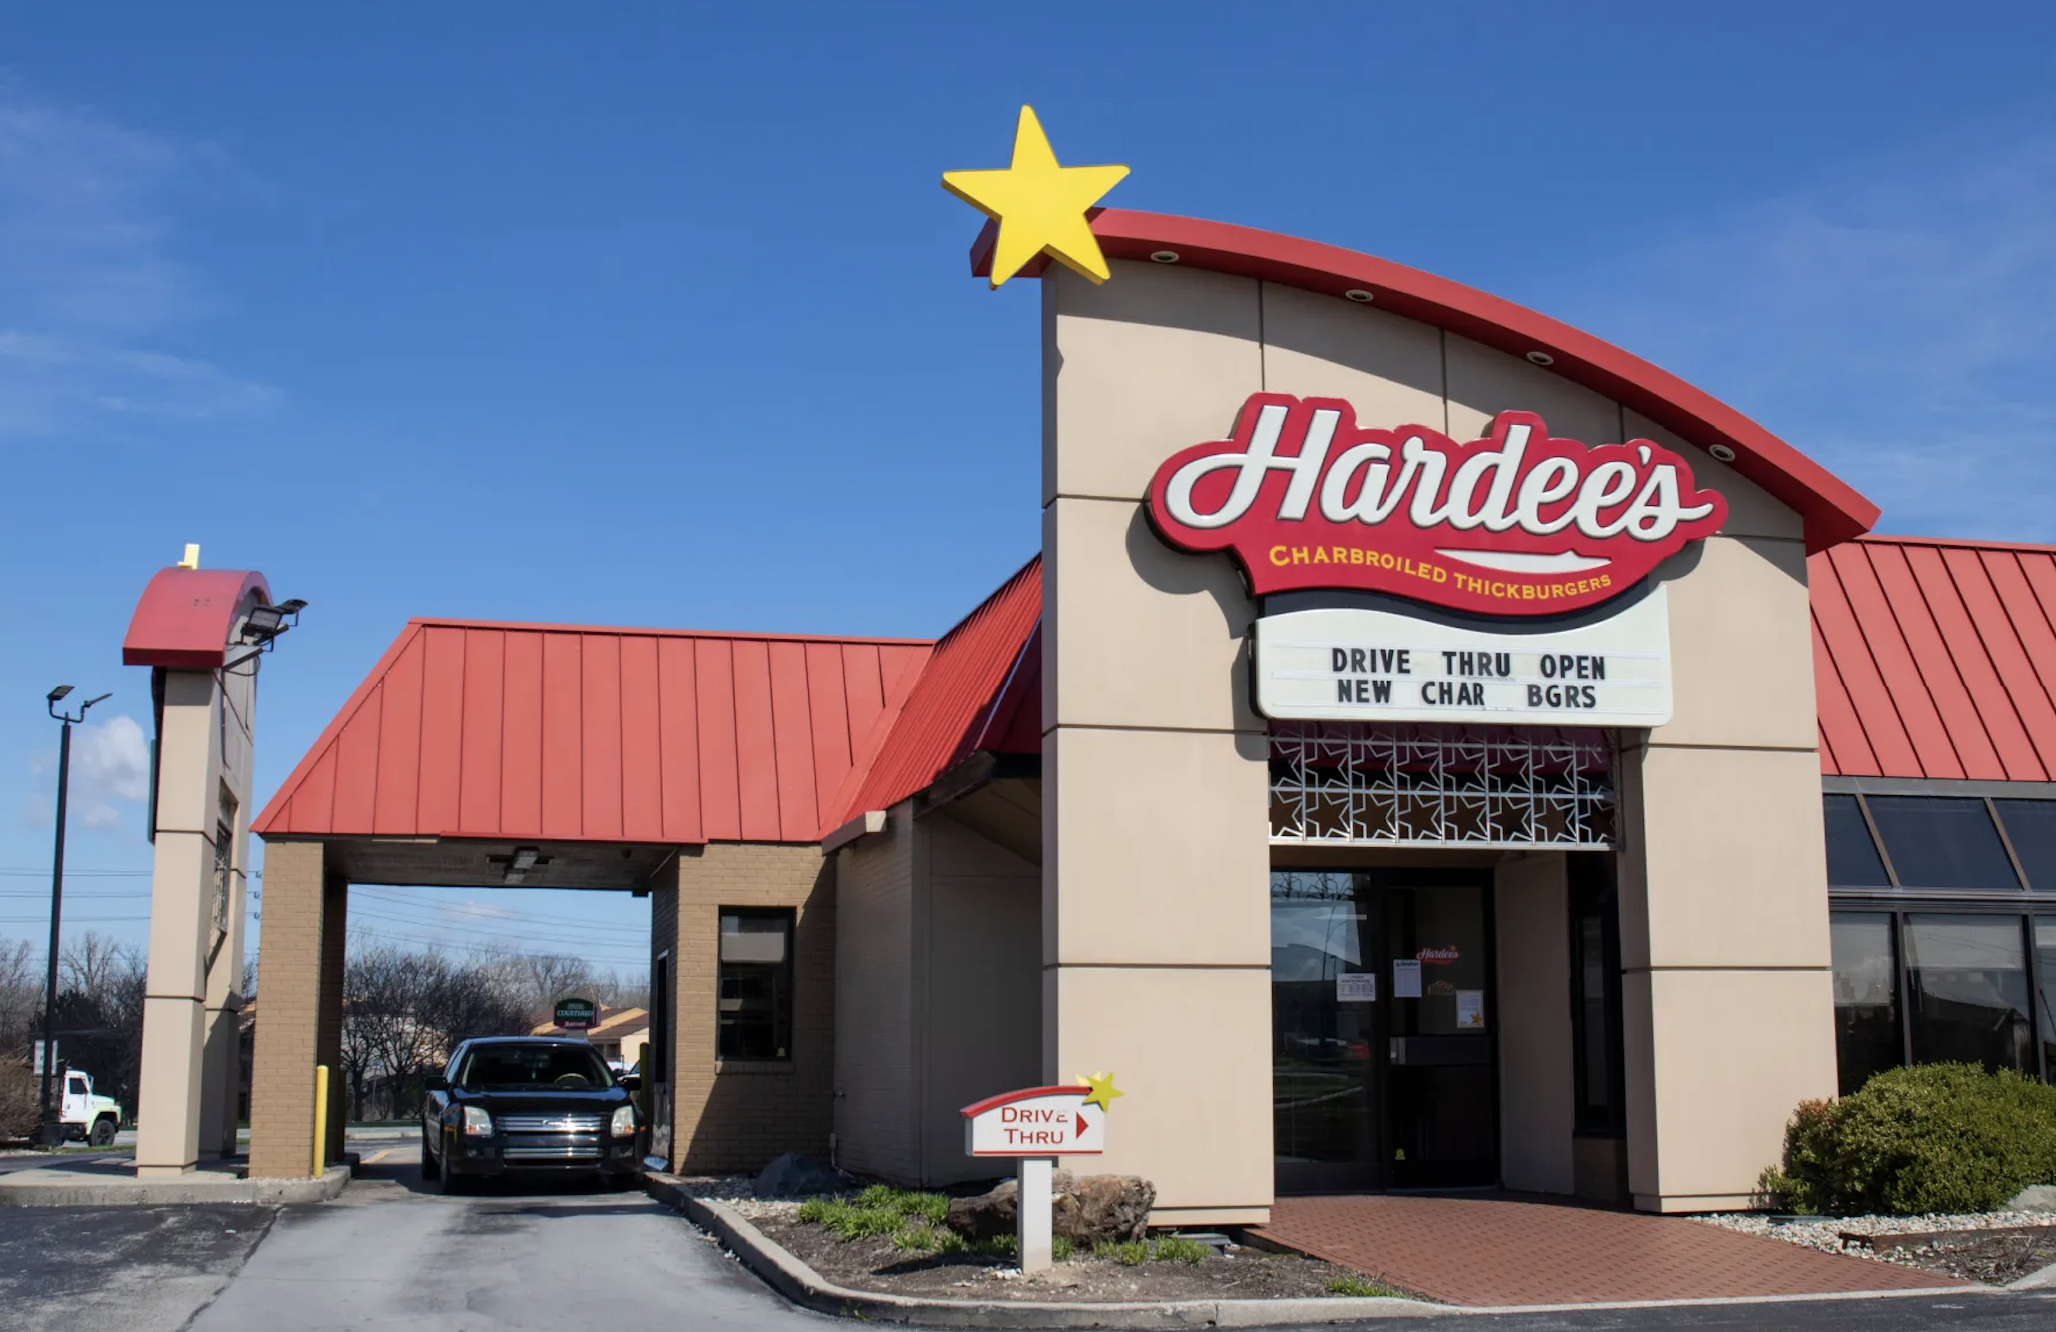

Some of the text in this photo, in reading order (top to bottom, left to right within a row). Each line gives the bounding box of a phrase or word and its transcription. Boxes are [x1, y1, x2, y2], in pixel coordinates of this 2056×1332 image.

[1164, 403, 1715, 543] Hardee's
[1269, 545, 1613, 600] CHARBROILED THICKBURGERS
[1332, 647, 1606, 680] DRIVE THRU OPEN
[1337, 679, 1597, 709] NEW CHAR BGRS
[1001, 1107, 1068, 1123] DRIVE
[1004, 1128, 1065, 1144] THRU
